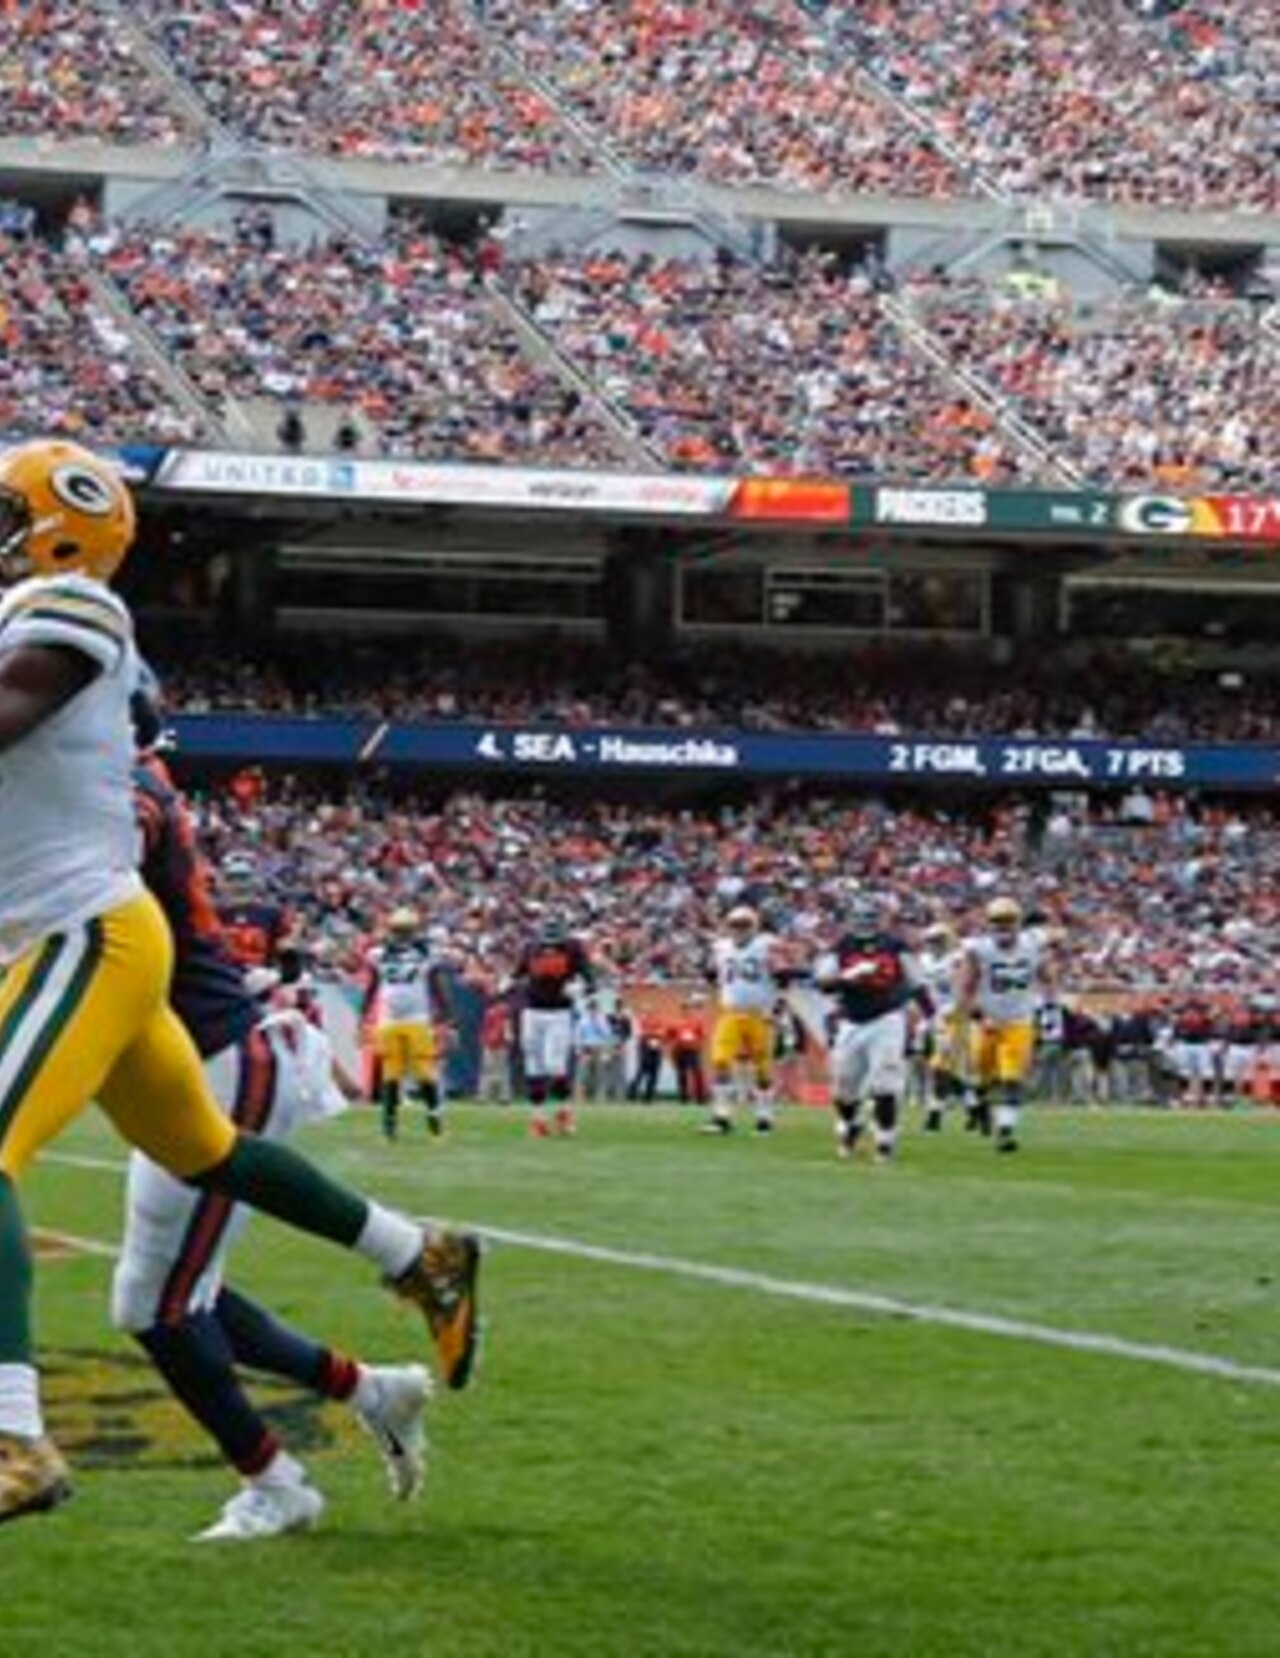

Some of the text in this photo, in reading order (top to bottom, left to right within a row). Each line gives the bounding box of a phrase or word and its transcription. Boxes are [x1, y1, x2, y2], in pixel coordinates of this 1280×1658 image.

[204, 461, 317, 488] UNITED
[528, 480, 597, 499] verizon
[876, 489, 987, 525] PACKERS
[1226, 501, 1267, 534] 17
[476, 731, 504, 760] 4.
[513, 732, 577, 762] SEA
[599, 735, 739, 768] Hauschka
[913, 744, 987, 776] FGM,
[1126, 749, 1187, 778] PTS
